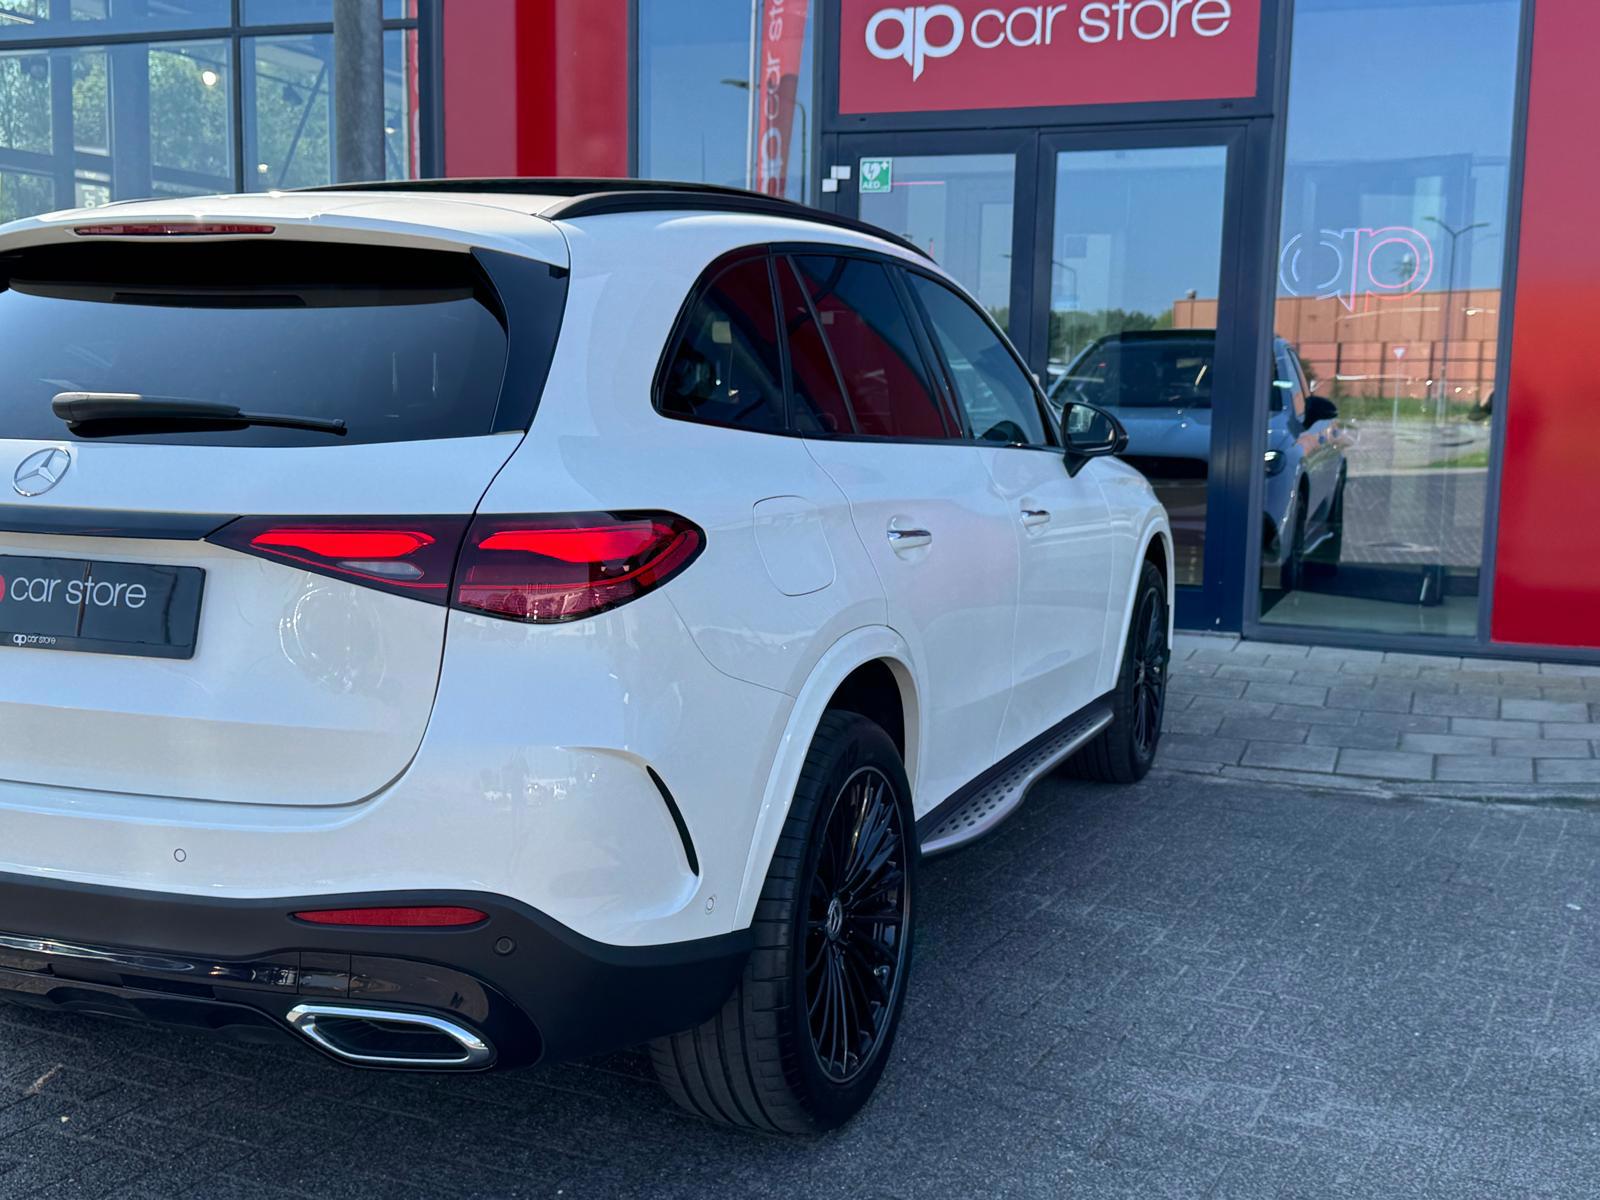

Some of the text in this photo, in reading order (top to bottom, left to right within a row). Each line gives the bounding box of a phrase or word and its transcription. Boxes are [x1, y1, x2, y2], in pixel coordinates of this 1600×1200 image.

[865, 0, 1232, 82] ap car store
[764, 53, 781, 120] car
[862, 181, 881, 190] AED
[10, 576, 62, 603] car
[65, 576, 147, 608] store
